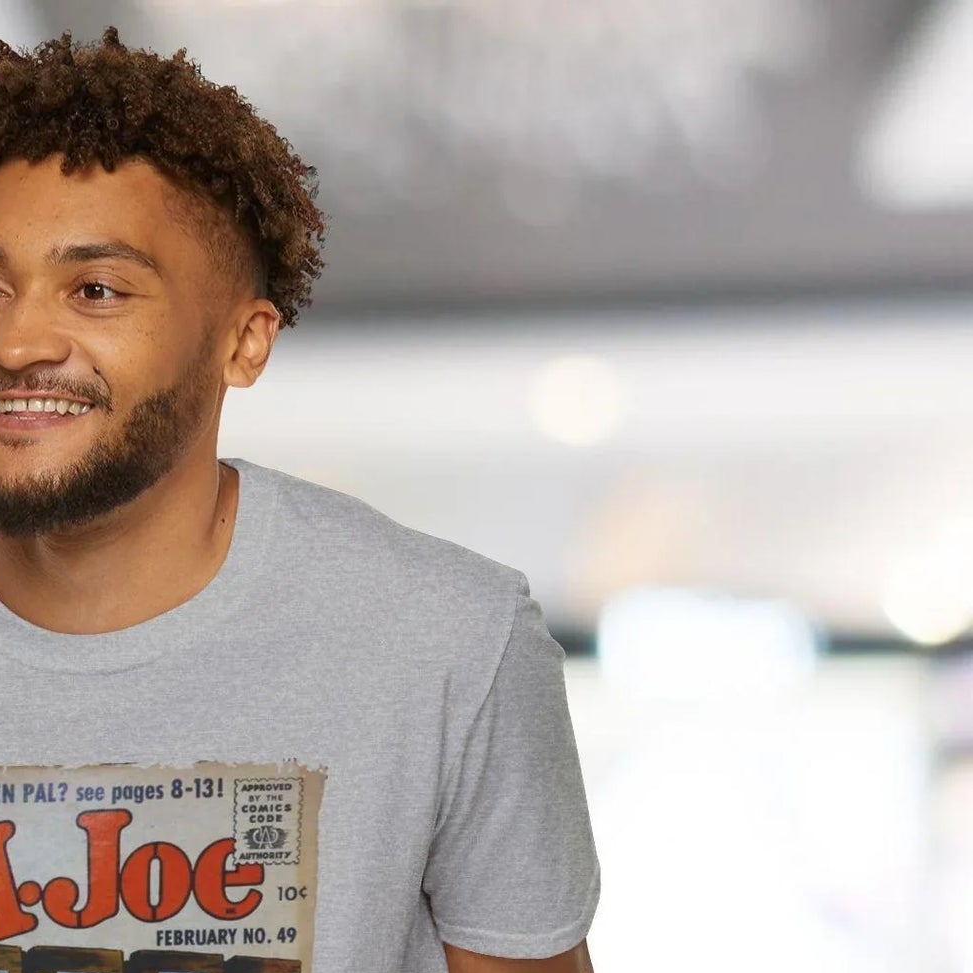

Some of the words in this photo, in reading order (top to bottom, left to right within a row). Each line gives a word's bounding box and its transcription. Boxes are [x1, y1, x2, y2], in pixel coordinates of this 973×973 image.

[23, 782, 68, 803] PAL?
[76, 786, 105, 801] see
[111, 784, 164, 804] pages
[171, 778, 223, 799] 8-13!
[241, 783, 292, 792] APPROVED
[241, 804, 292, 813] COMICS
[249, 814, 283, 823] CODE
[239, 852, 292, 860] AUTHORITY
[278, 886, 308, 901] 10¢
[156, 929, 237, 946] FEBRUARY
[243, 928, 272, 944] NO.
[277, 927, 297, 944] 49
